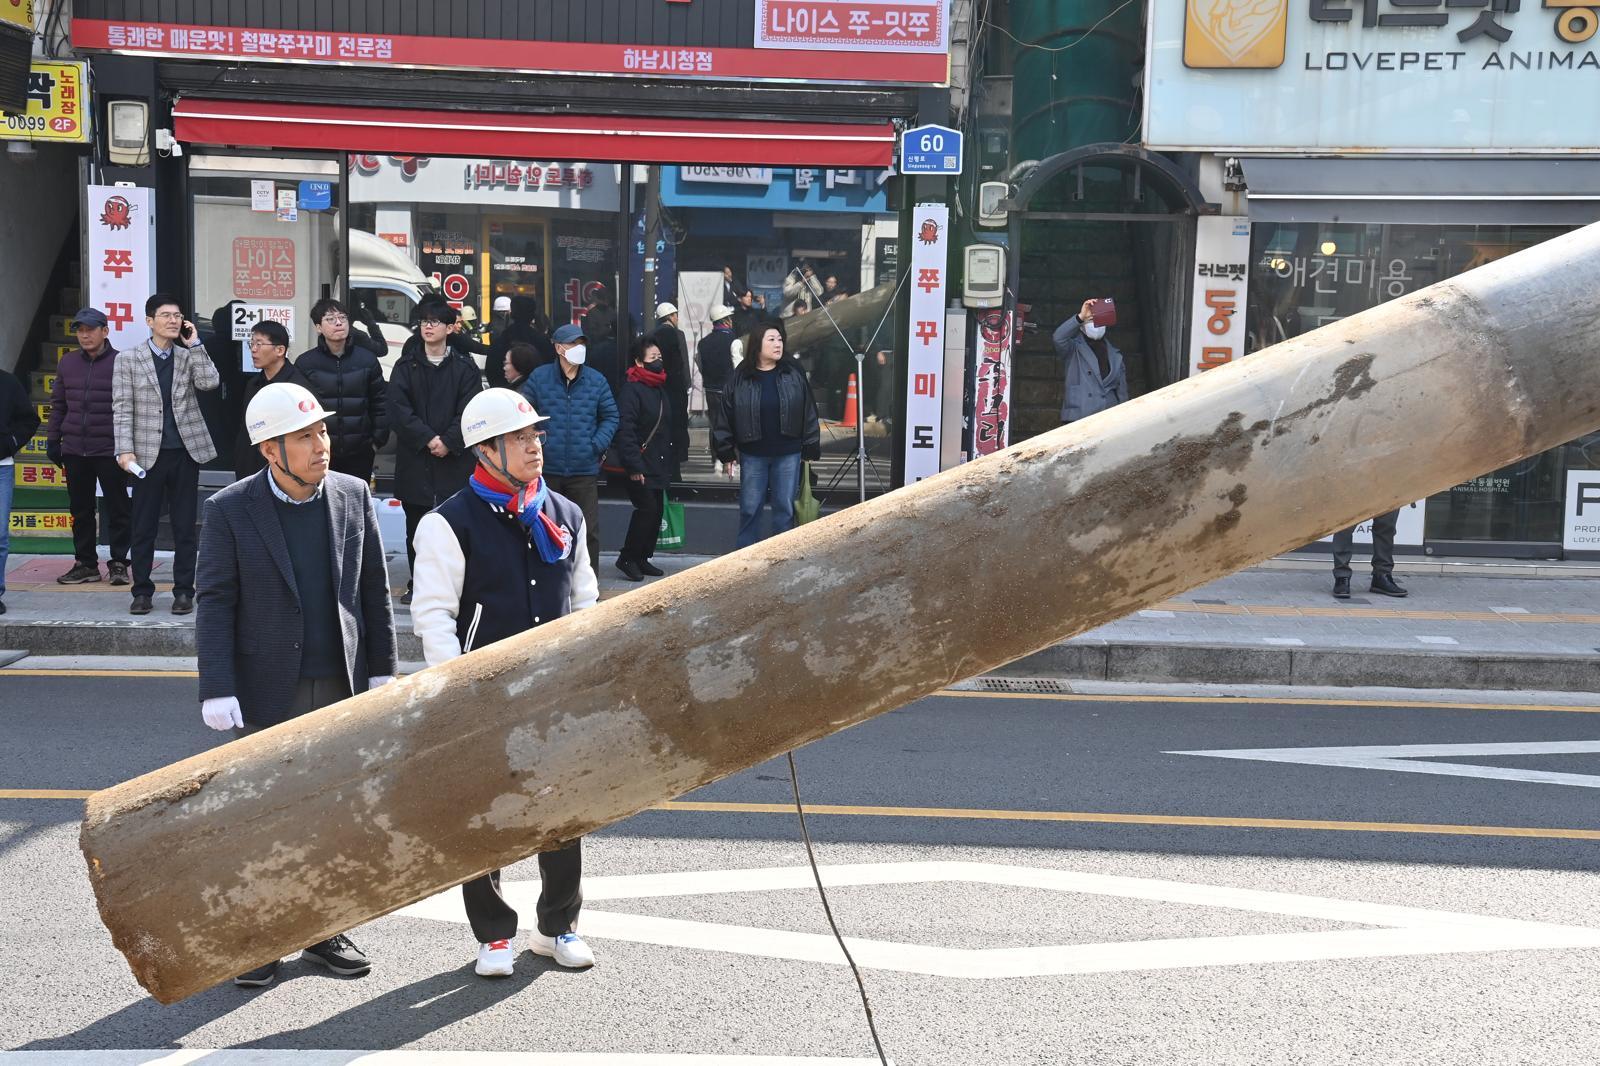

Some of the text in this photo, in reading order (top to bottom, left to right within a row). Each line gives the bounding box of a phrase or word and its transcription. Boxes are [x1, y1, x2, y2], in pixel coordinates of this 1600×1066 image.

[772, 8, 930, 38] 나이스 쭈-밋쭈
[108, 26, 392, 58] 통쾌한 매운맛! 철판쭈꾸미 전문점
[623, 48, 713, 71] 하남시청점
[1305, 52, 1466, 71] LOVEPET
[54, 119, 71, 131] 2F
[920, 134, 944, 152] 60
[235, 248, 293, 270] 나이스
[1198, 263, 1246, 281] 러브펫
[1274, 256, 1413, 298] 애견미용
[234, 307, 264, 325] 2+1
[267, 308, 291, 318] TAKE
